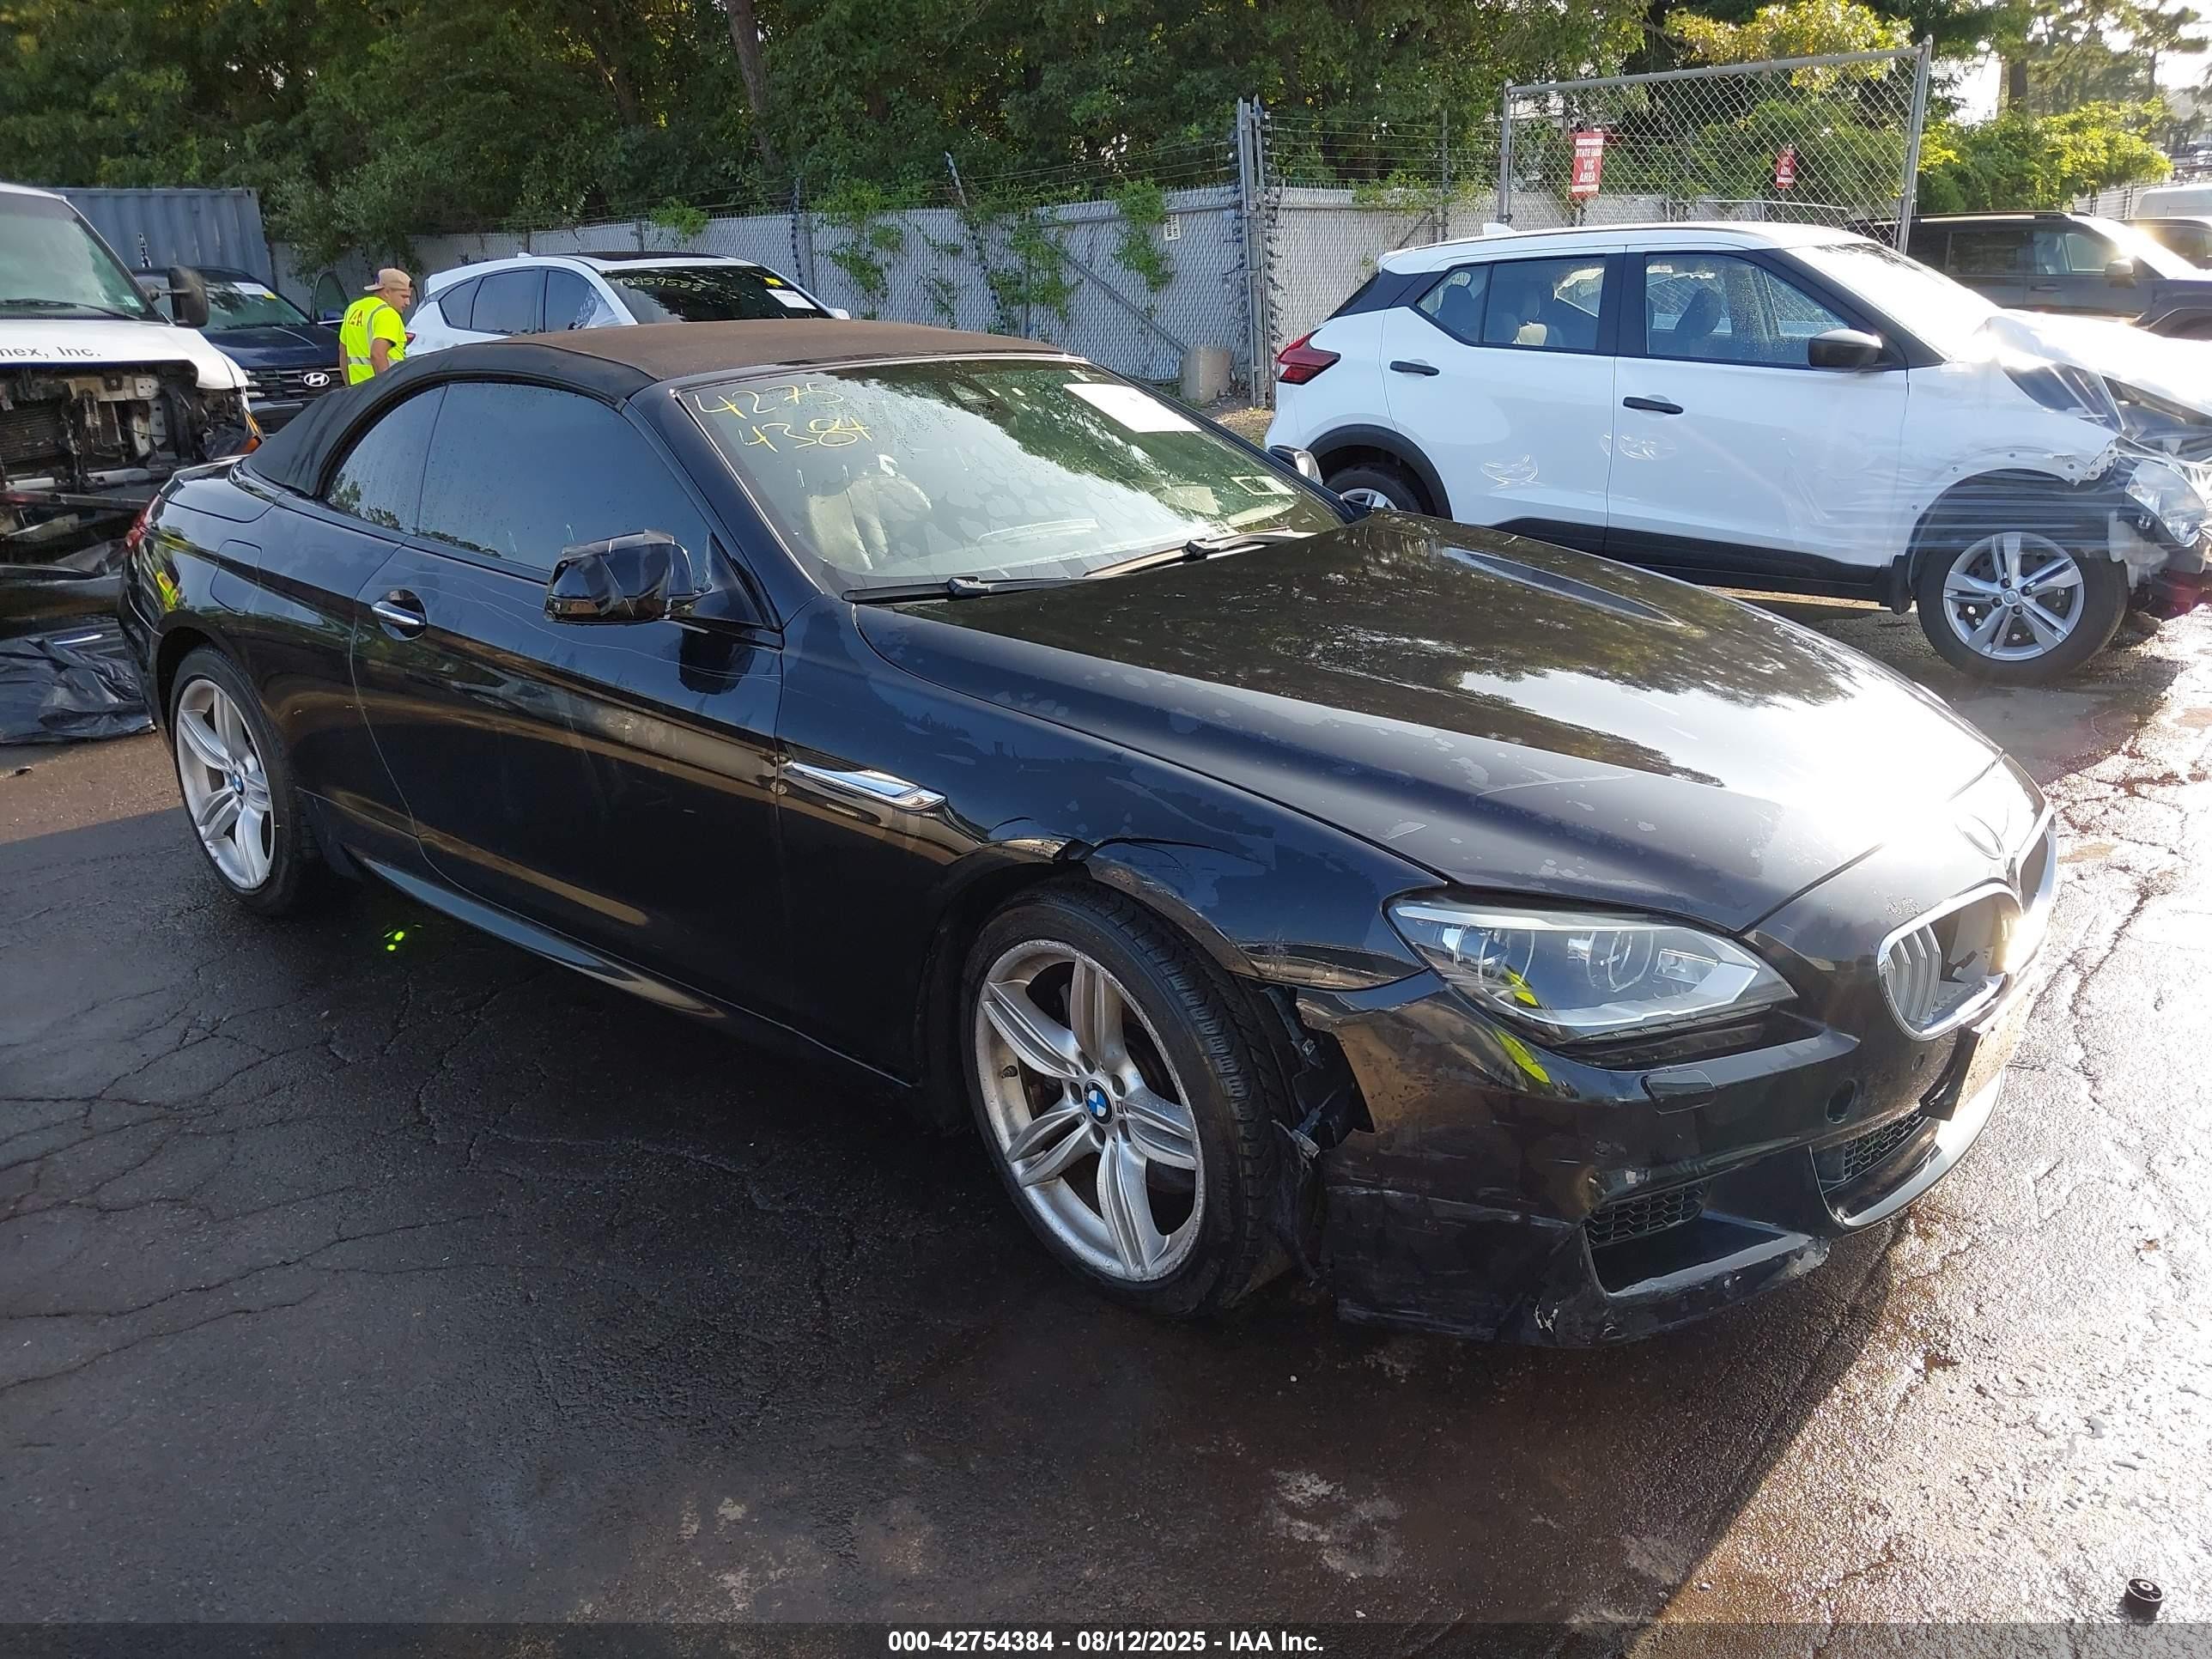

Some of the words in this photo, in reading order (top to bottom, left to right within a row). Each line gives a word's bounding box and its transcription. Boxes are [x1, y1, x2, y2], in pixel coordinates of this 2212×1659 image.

[1576, 148, 1590, 158] STATE
[1583, 159, 1595, 170] VIC
[1579, 172, 1595, 182] AREA
[57, 346, 101, 357] Inc.
[695, 383, 845, 419] 4275
[738, 416, 872, 453] 4384
